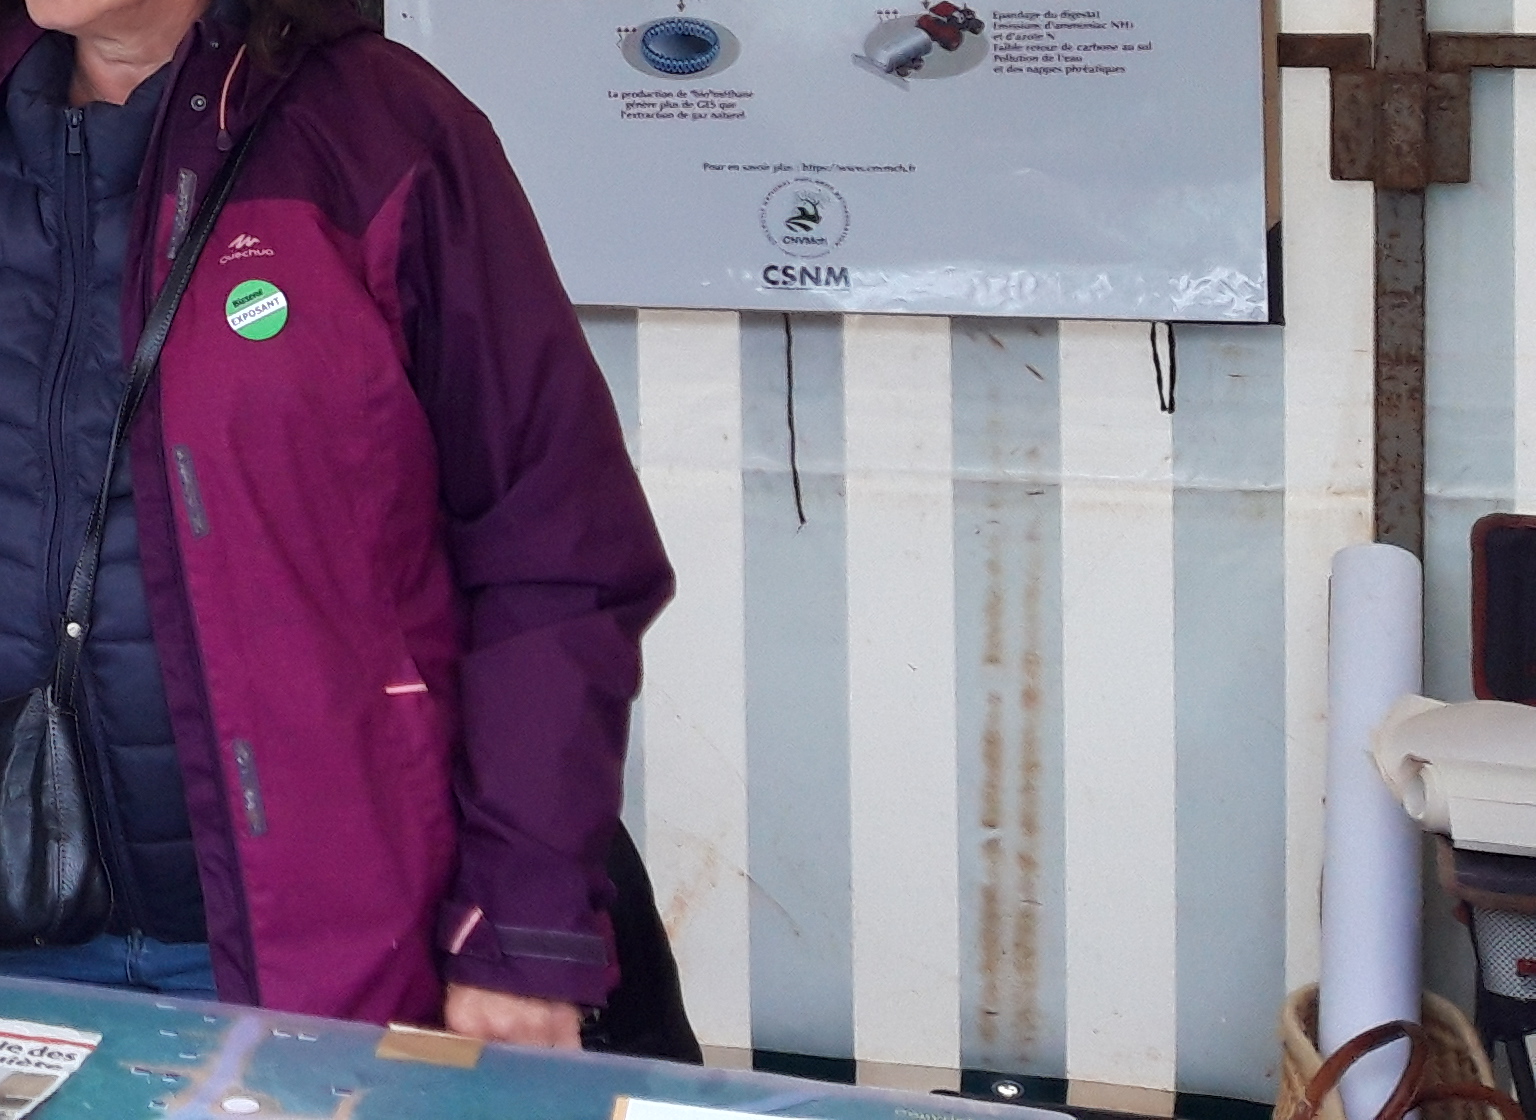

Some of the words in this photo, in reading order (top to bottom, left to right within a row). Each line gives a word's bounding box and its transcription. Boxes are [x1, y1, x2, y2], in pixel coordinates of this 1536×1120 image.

[762, 265, 850, 287] CSNM
[231, 296, 281, 327] EXPOSANT
[28, 1045, 77, 1062] des
